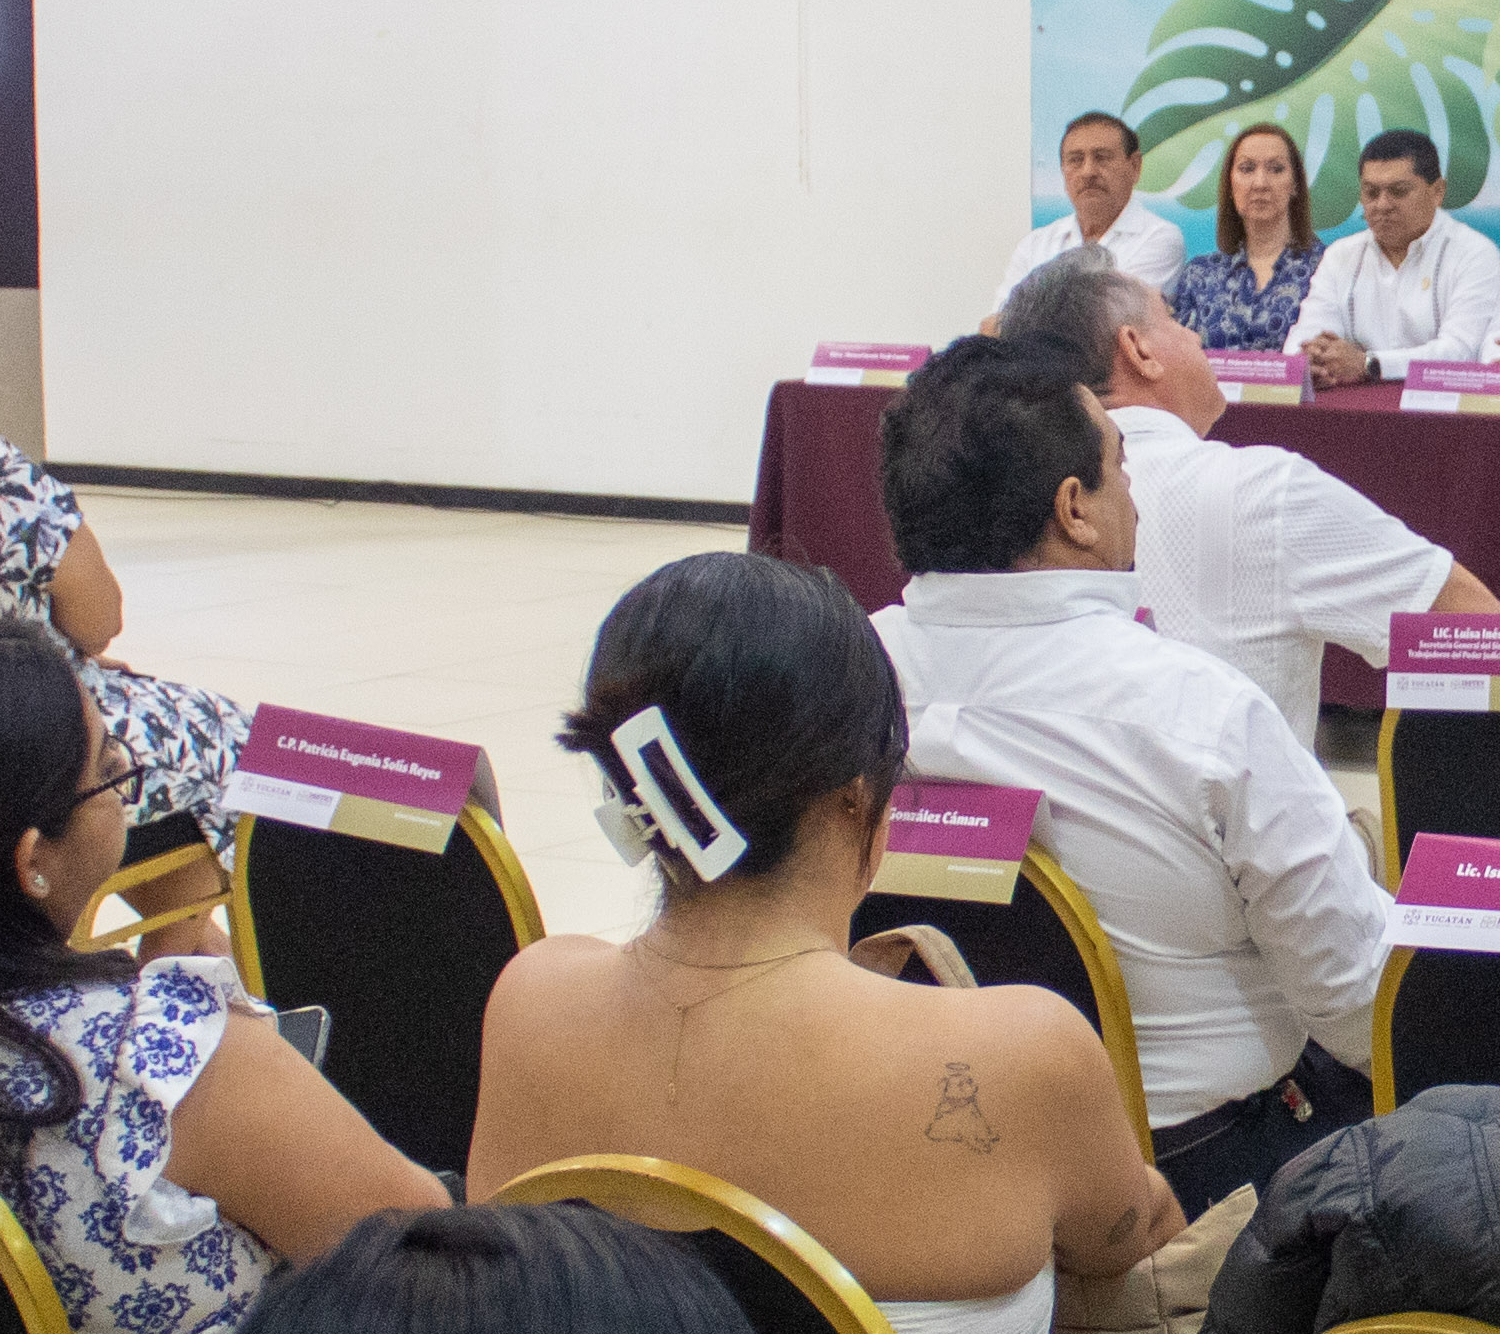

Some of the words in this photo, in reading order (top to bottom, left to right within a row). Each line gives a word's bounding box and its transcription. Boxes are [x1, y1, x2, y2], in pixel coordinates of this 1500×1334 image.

[1454, 627, 1480, 640] Luisa
[276, 735, 297, 752] C.P.
[297, 739, 339, 760] Patricia
[339, 748, 382, 768] Eugenia
[409, 762, 442, 781] Reyes
[942, 810, 990, 828] Cámara
[1456, 863, 1481, 878] Lic.
